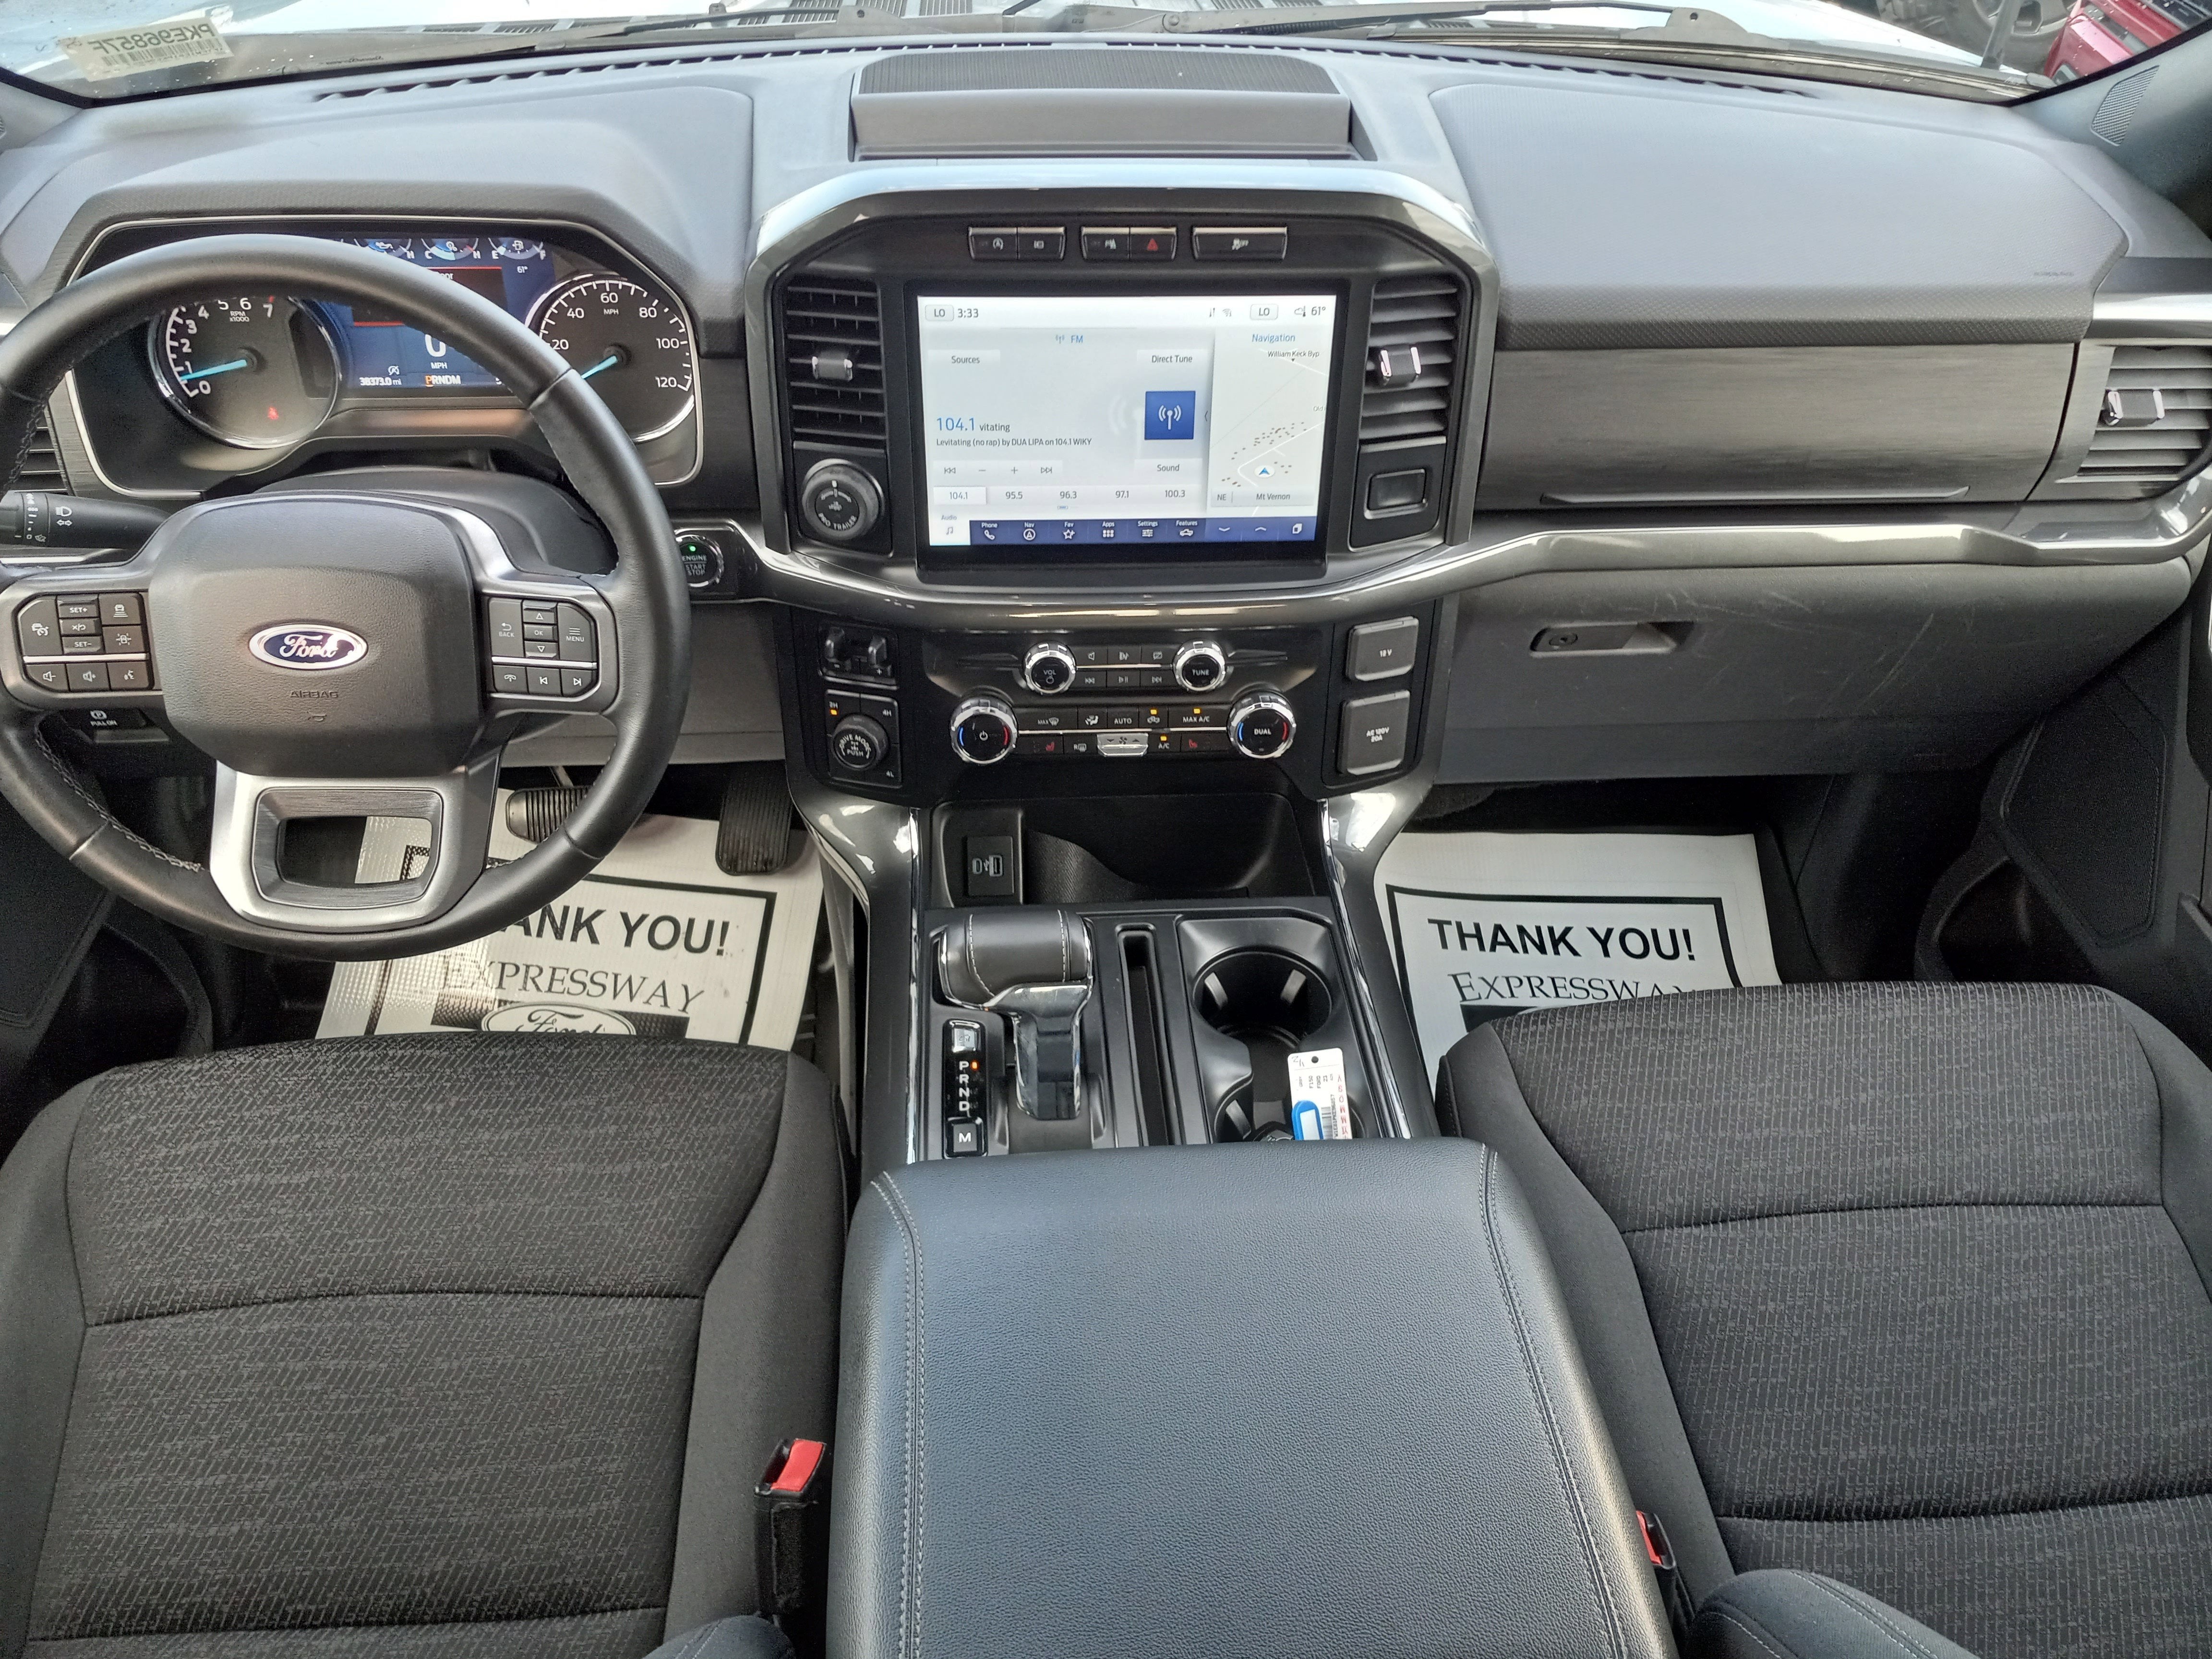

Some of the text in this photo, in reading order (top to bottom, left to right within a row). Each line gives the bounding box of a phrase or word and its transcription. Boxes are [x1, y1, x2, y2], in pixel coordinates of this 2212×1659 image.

[425, 251, 433, 259] C
[473, 251, 481, 259] H
[492, 251, 499, 259] E
[600, 292, 618, 303] 60
[240, 298, 252, 310] 6
[198, 305, 209, 320] 4
[263, 303, 273, 318] 7
[566, 308, 585, 318] 40
[639, 307, 657, 318] 80
[934, 309, 946, 317] LO
[957, 308, 979, 318] 3:33
[1258, 308, 1270, 316] LO
[1311, 306, 1326, 316] 61°
[185, 319, 197, 334] 3
[656, 338, 680, 349] 100
[1070, 335, 1083, 344] FM
[1251, 333, 1296, 344] Navigation
[180, 338, 192, 353] 2
[552, 339, 569, 350] 20
[951, 356, 980, 364] Sources
[1152, 355, 1173, 363] Direct
[185, 361, 192, 373] 1
[199, 380, 211, 395] 0
[655, 376, 677, 388] 120
[937, 417, 1011, 433] 104.1 vitating
[936, 438, 971, 447] Levitating
[973, 438, 985, 447] (no
[986, 438, 1000, 447] rap)
[1002, 438, 1010, 447] by
[1156, 464, 1180, 472] Sound
[949, 492, 969, 500] 104.1
[1005, 491, 1023, 500] 95.5
[1059, 491, 1077, 499] 96.3
[1115, 490, 1129, 499] 97.1
[1165, 490, 1186, 498] 100.3
[279, 634, 338, 658] Ford
[290, 690, 339, 698] AIRBAG
[619, 911, 730, 956] YOU!
[1427, 917, 1696, 961] THANK YOU!
[959, 1060, 970, 1071] P
[959, 1073, 969, 1084] R
[959, 1087, 970, 1098] N
[959, 1101, 970, 1111] D
[959, 1132, 972, 1143] M
